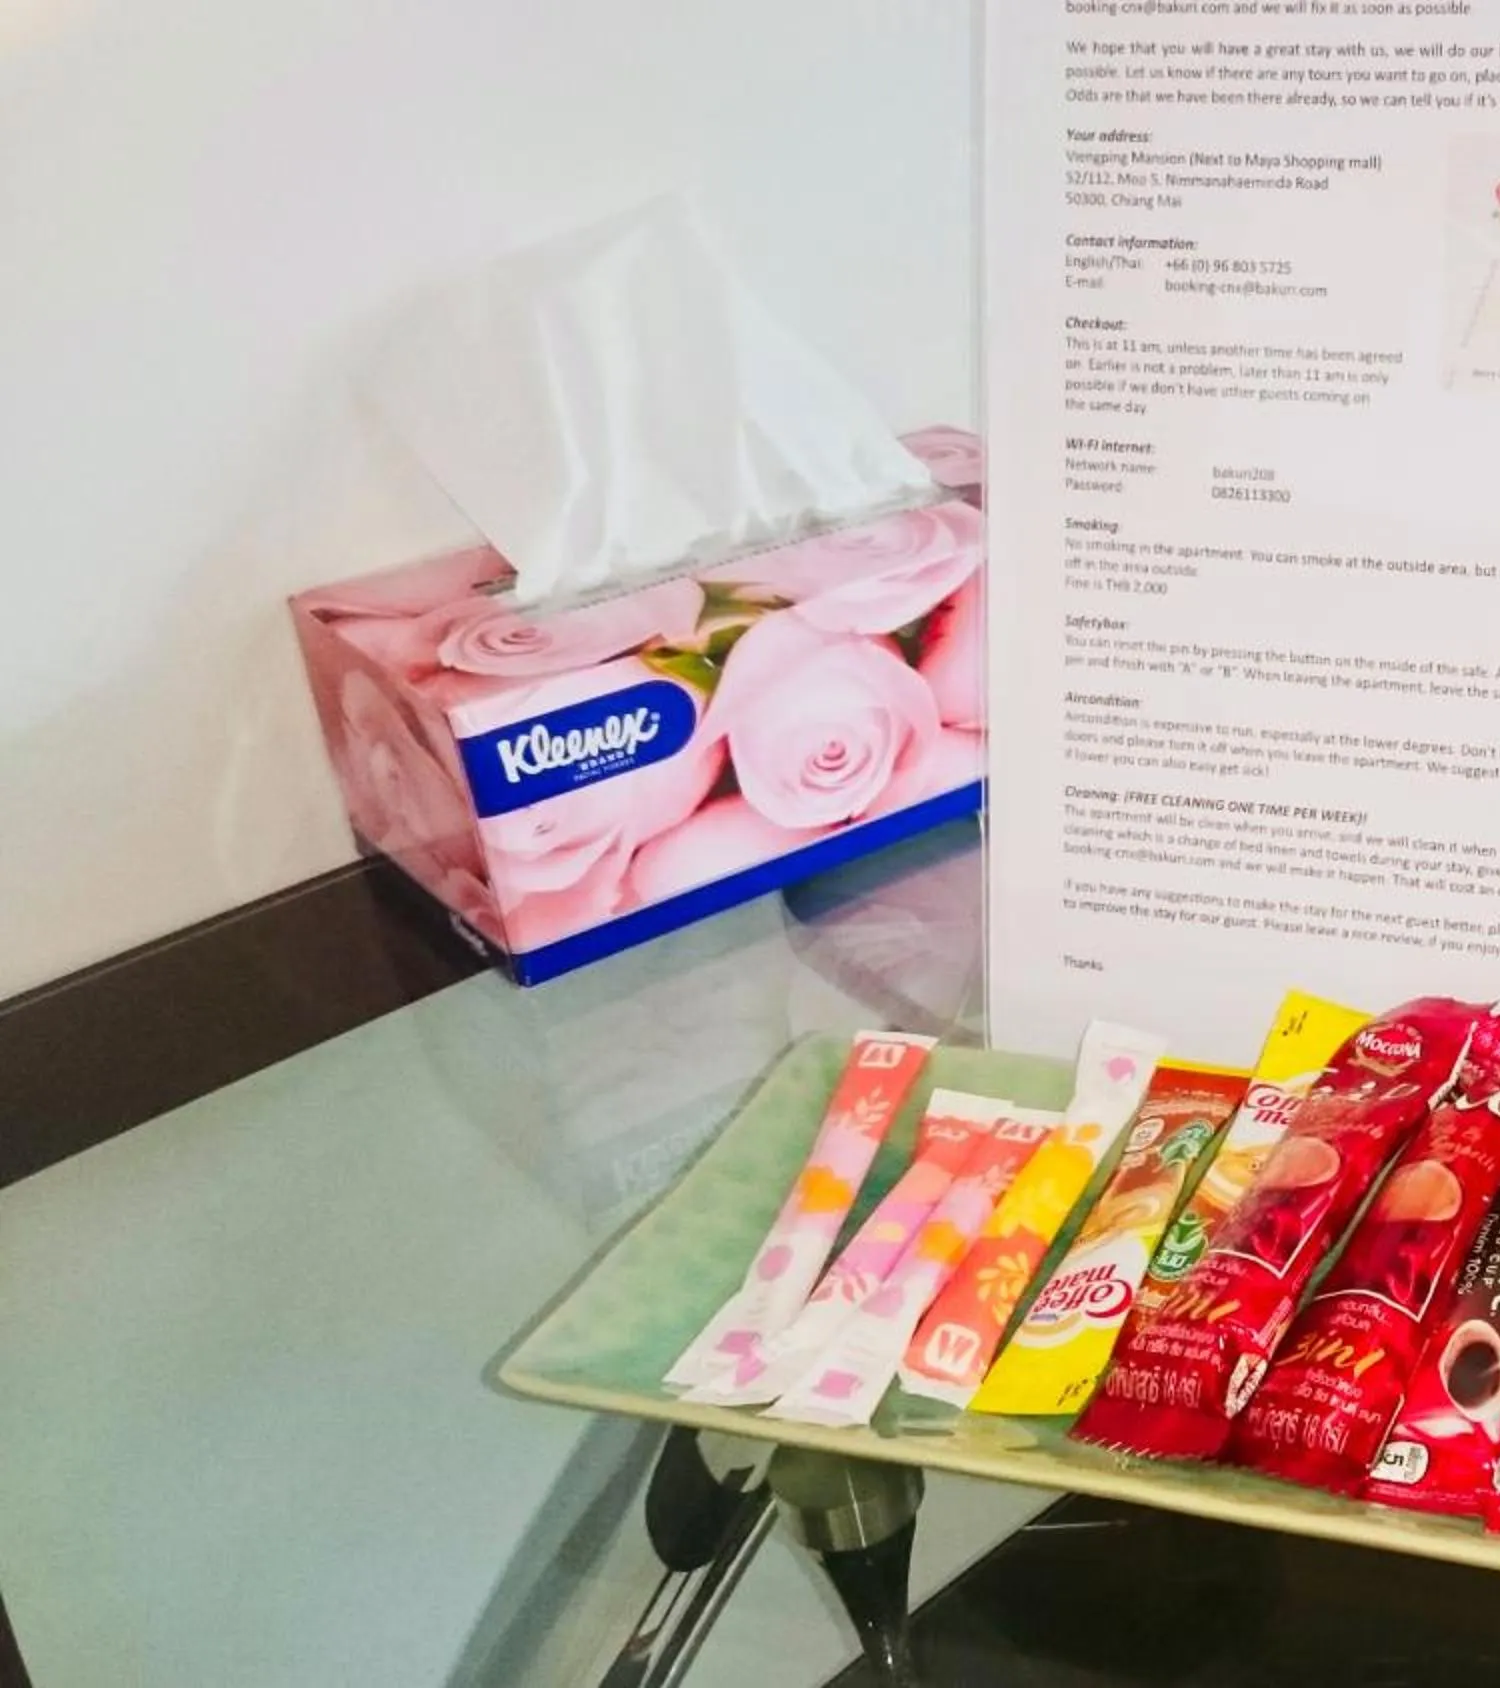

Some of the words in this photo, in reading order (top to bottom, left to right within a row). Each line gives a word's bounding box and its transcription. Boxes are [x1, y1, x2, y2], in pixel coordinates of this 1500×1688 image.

[1066, 41, 1087, 53] We
[1092, 41, 1125, 56] hope
[1128, 41, 1156, 54] that
[1217, 42, 1249, 55] have
[1264, 44, 1300, 58] great
[1304, 44, 1332, 58] stay
[1335, 43, 1366, 56] with
[1469, 47, 1494, 57] our
[1166, 66, 1202, 79] know
[1217, 66, 1253, 80] there
[1256, 69, 1278, 80] are
[1281, 70, 1305, 83] any
[1307, 68, 1342, 80] tours
[1373, 70, 1408, 81] want
[1064, 88, 1098, 102] Odds
[1124, 89, 1151, 102] that
[1176, 89, 1208, 103] have
[1210, 90, 1244, 104] been
[1246, 91, 1282, 104] there
[1285, 90, 1337, 106] already,
[1382, 95, 1407, 106] can
[1410, 92, 1432, 106] tell
[1066, 128, 1096, 141] Your
[1064, 234, 1115, 247] Contact
[1164, 258, 1189, 271] +66
[1212, 259, 1229, 272] 96
[1230, 259, 1257, 273] 803
[1258, 260, 1292, 274] 5725
[1300, 554, 1342, 567] smoke
[1360, 556, 1383, 570] the
[1386, 560, 1435, 573] outside
[1474, 563, 1496, 576] but
[498, 708, 659, 782] Kleenex
[1362, 735, 1399, 749] lower
[1460, 743, 1496, 757] Don't
[1160, 795, 1224, 810] CLEANING
[1227, 800, 1255, 812] ONE
[1257, 803, 1290, 815] TIME
[1292, 807, 1317, 817] PER
[1232, 820, 1268, 834] when
[1391, 873, 1420, 887] That
[1482, 1254, 1500, 1289] CUP
